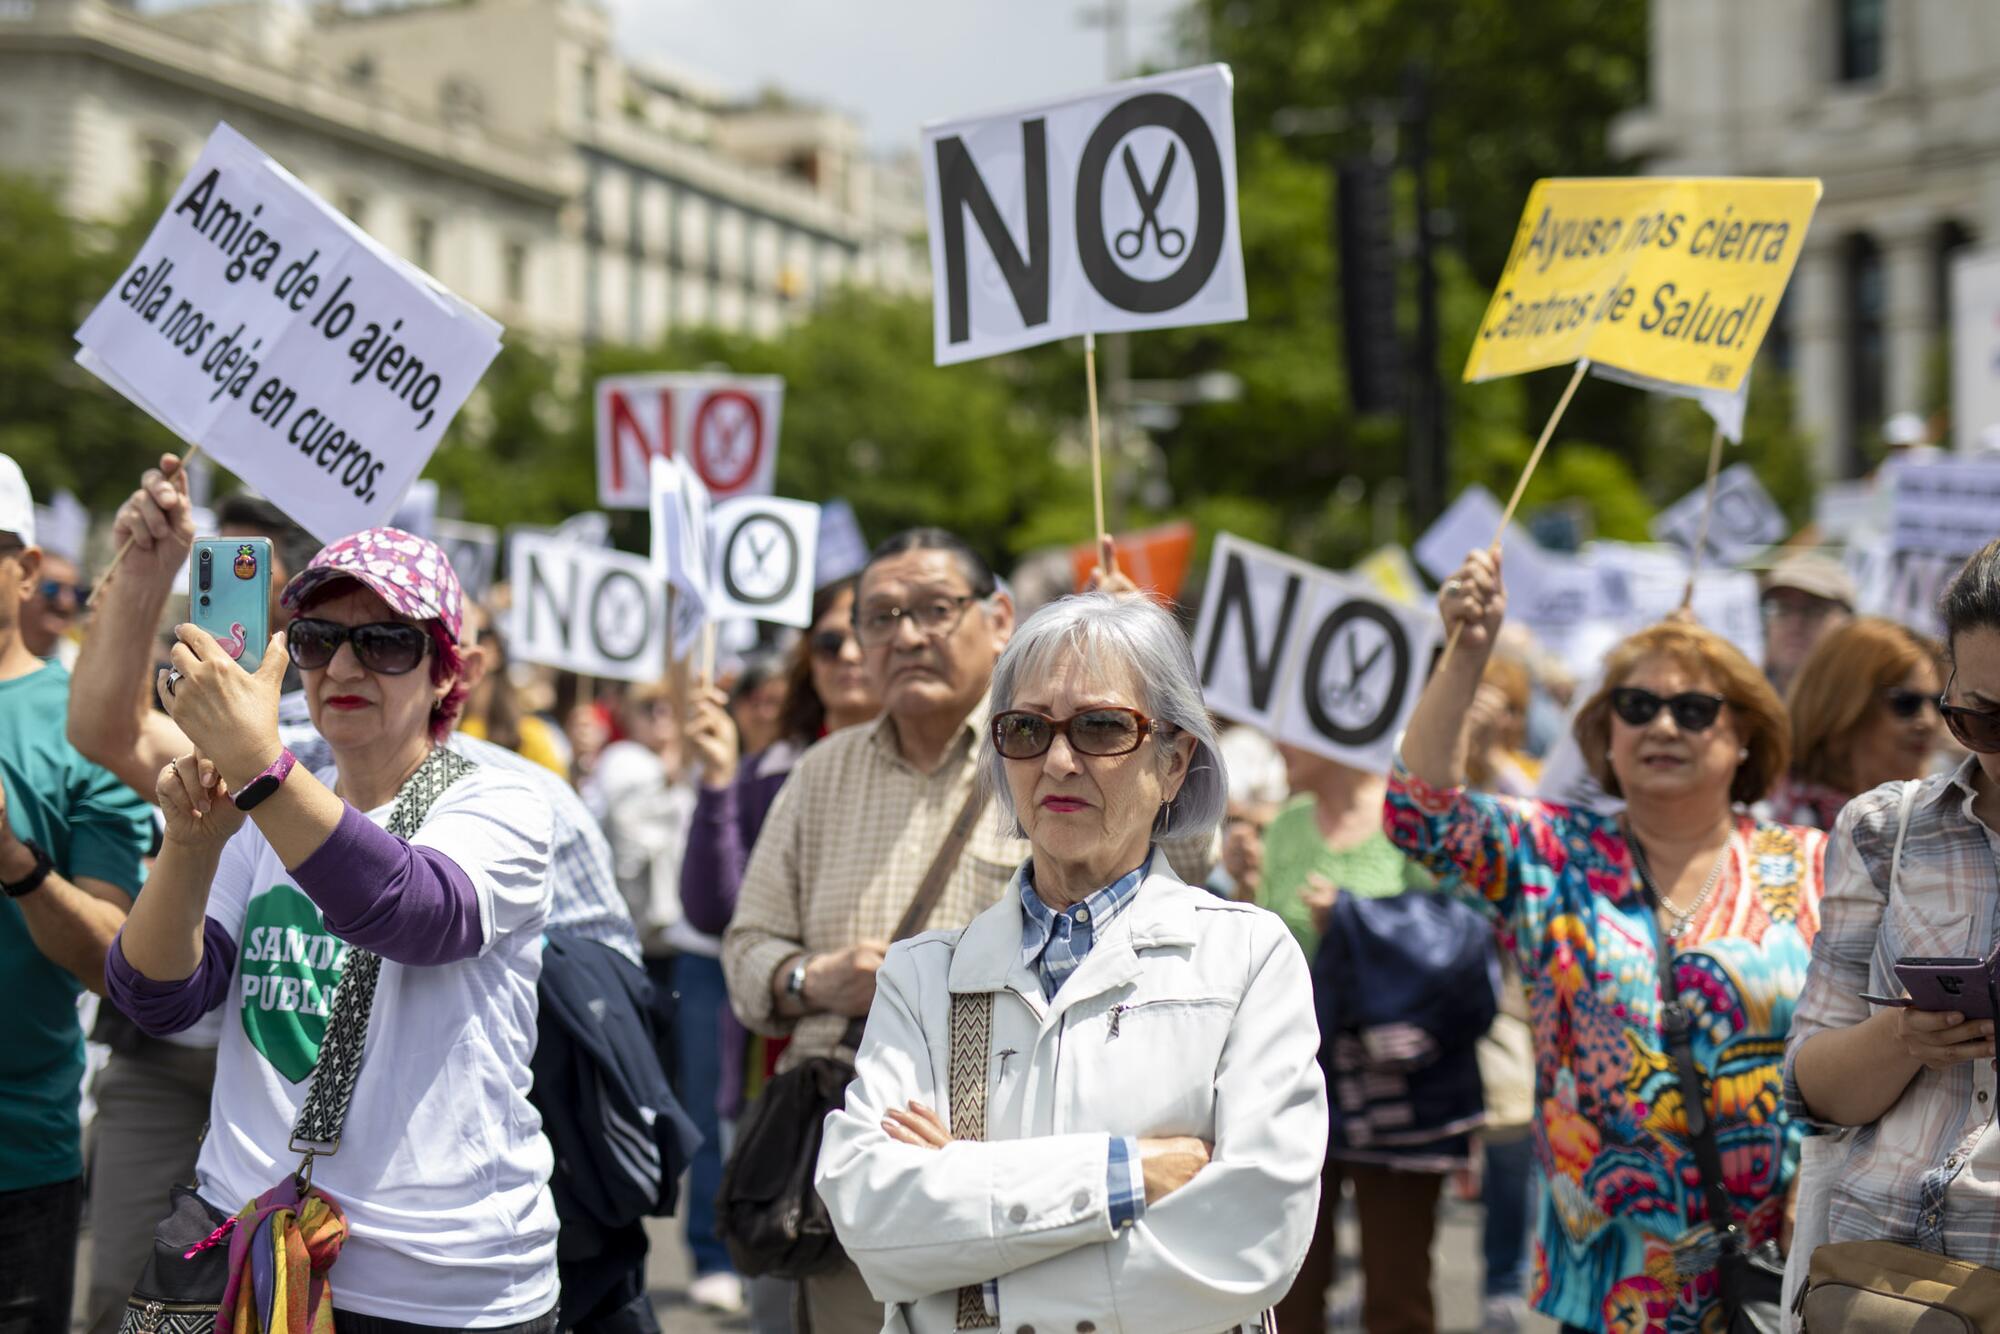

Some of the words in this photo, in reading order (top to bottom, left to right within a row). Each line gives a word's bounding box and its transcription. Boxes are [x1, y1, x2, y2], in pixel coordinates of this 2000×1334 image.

[935, 92, 1226, 345] NO
[1624, 213, 1686, 251] nos
[1689, 203, 1790, 264] cierra
[174, 167, 281, 283] Amiga
[273, 249, 319, 312] de
[310, 276, 355, 339] lo
[348, 318, 441, 431] ajeno,
[1484, 289, 1596, 339] Centros
[1593, 272, 1636, 322] de
[1639, 283, 1765, 350] Salud!
[119, 258, 174, 323] ella
[159, 299, 215, 357] nos
[201, 323, 262, 403] deja
[250, 377, 297, 428] en
[287, 407, 385, 505] cueros.
[608, 389, 764, 492] NO
[527, 552, 650, 663] NO
[1200, 552, 1410, 748] NO
[240, 964, 338, 1017] PÚBLI
